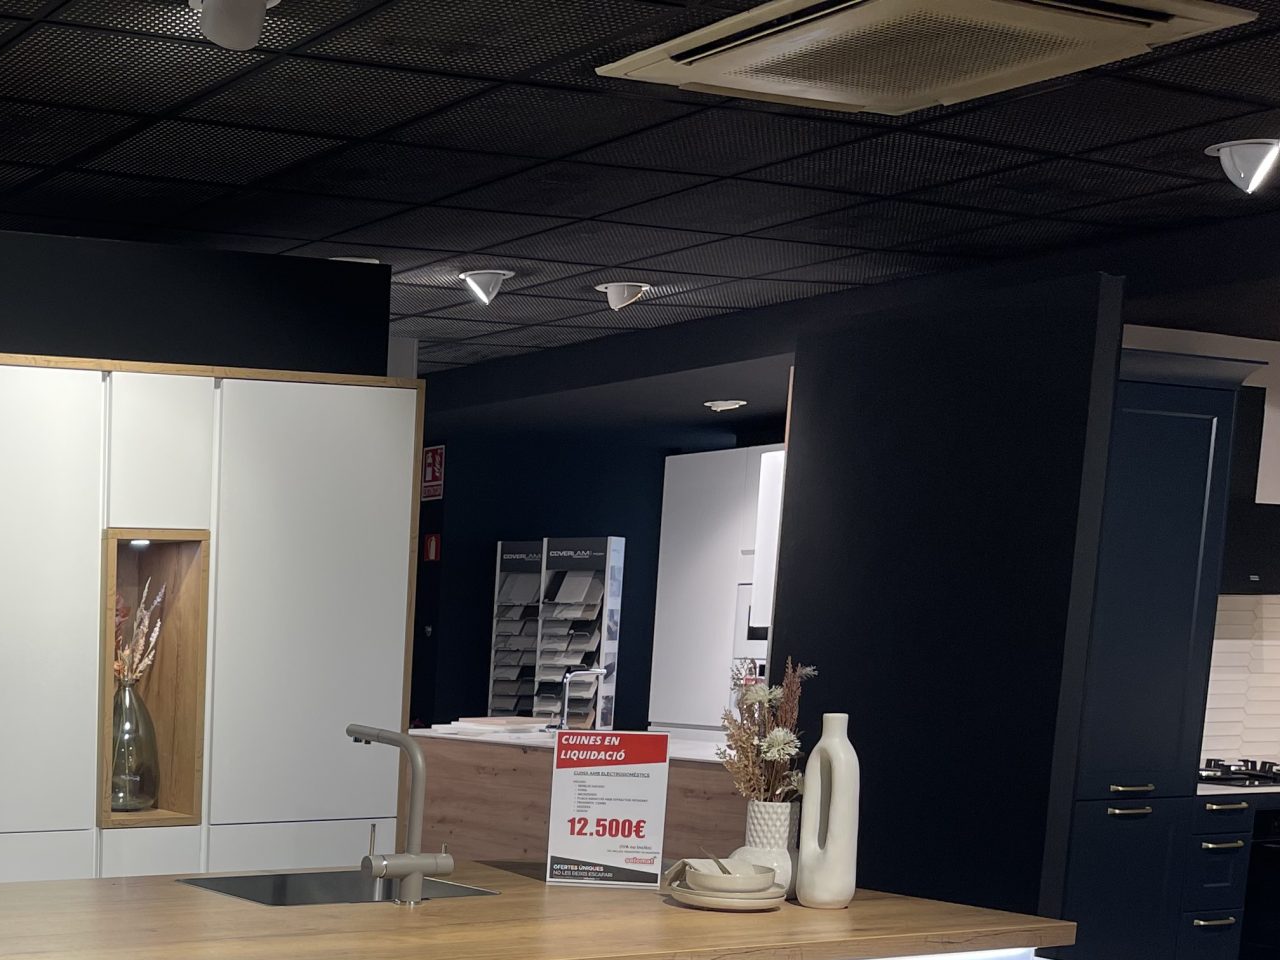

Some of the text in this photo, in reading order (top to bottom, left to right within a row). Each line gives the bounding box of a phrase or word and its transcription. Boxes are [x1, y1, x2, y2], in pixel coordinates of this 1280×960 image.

[561, 735, 620, 746] CUINES EN
[560, 749, 626, 761] LIQUIDACIÓ
[567, 817, 647, 838] 12.500€
[579, 864, 604, 872] ÚNIQUES
